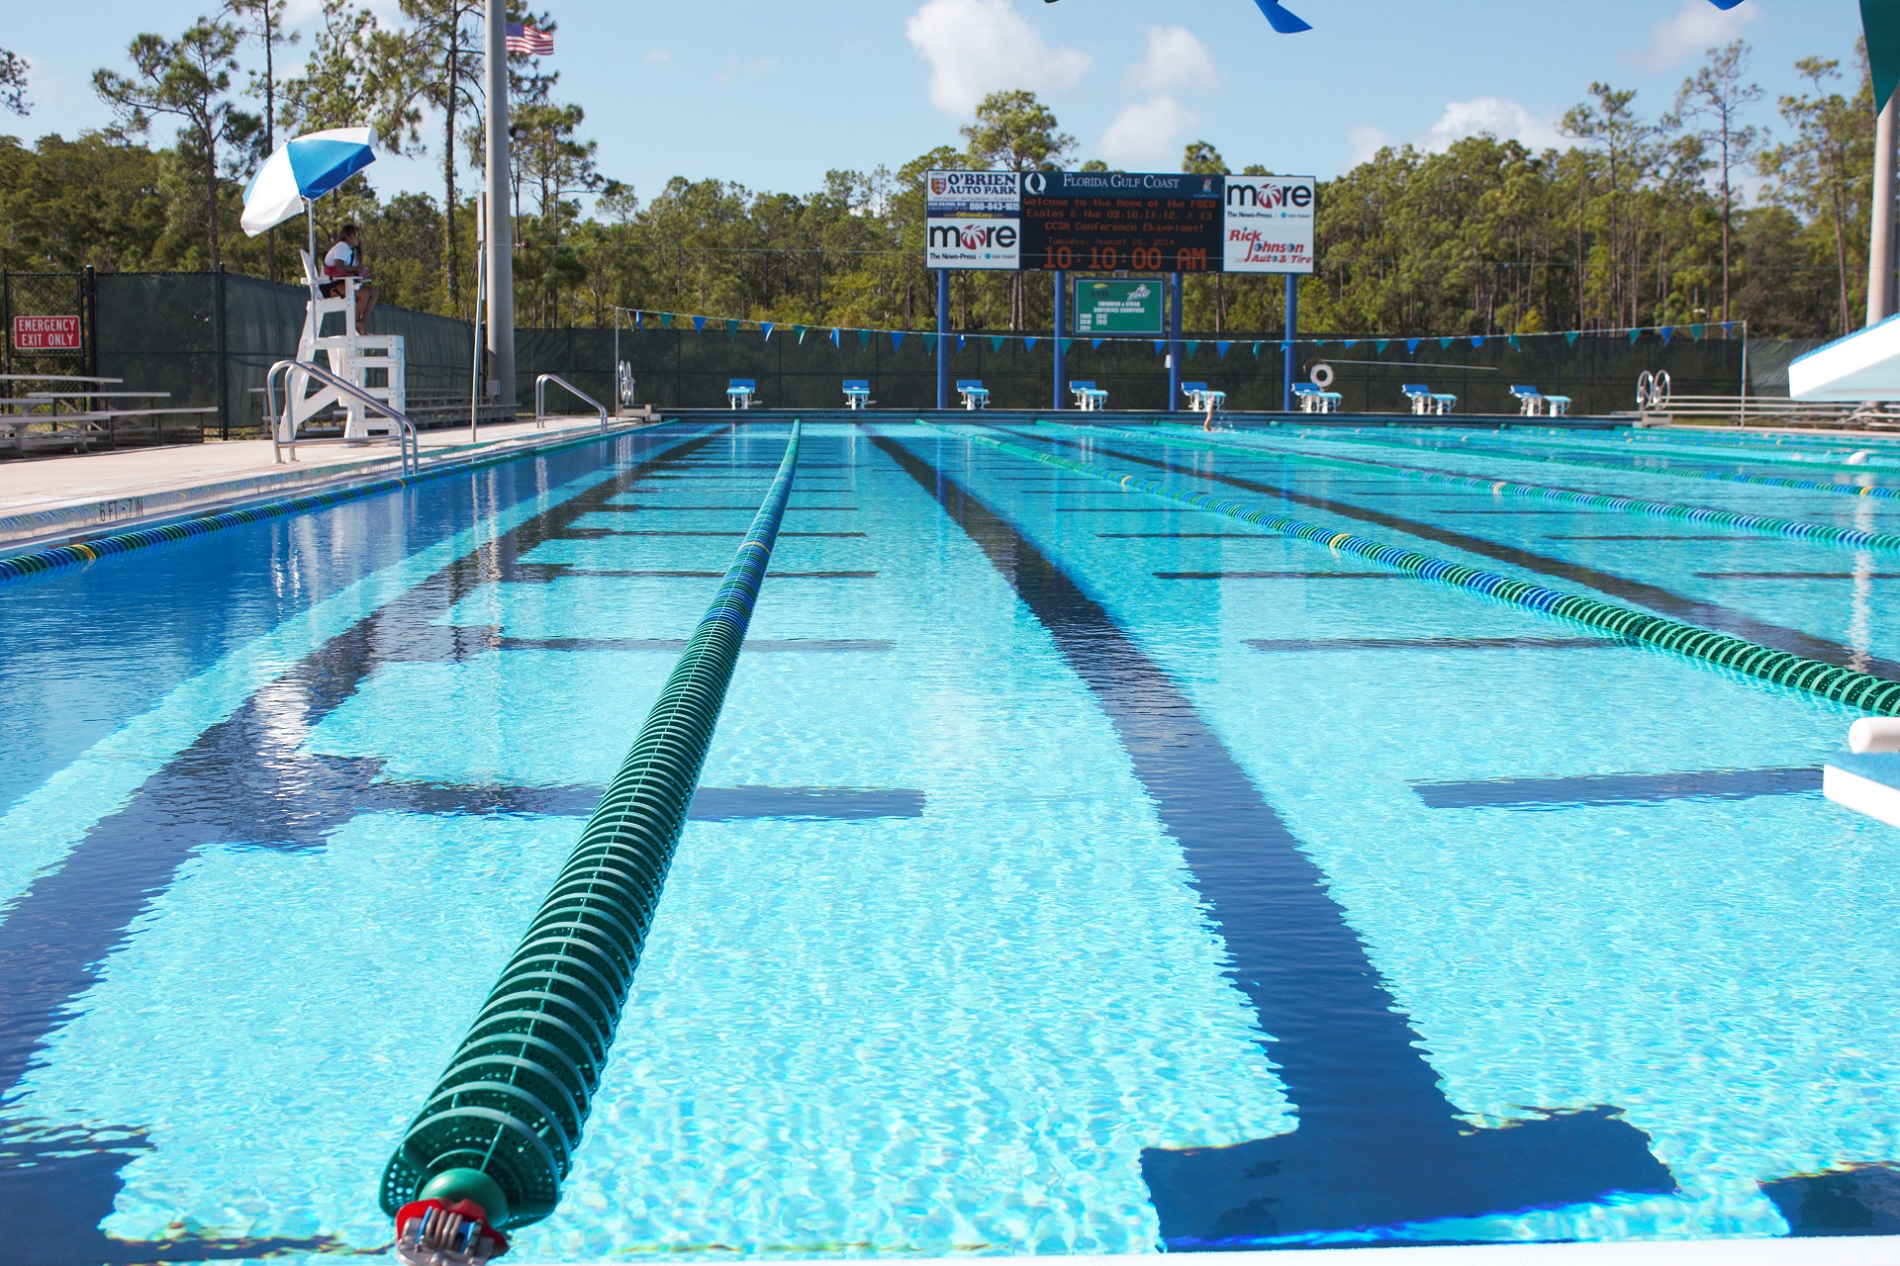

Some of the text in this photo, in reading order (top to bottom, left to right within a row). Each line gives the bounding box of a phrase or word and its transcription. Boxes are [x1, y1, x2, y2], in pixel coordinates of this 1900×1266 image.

[948, 174, 1017, 186] O'BRIEN
[1063, 174, 1180, 189] FLORIDA GULF COAST
[948, 186, 1017, 194] AUTO PARK
[1024, 198, 1068, 206] Welcome
[1075, 198, 1086, 206] to
[1093, 198, 1111, 206] the
[1117, 199, 1142, 207] Home
[1148, 199, 1159, 208] of
[1167, 200, 1185, 208] the
[1026, 209, 1064, 218] Eagles
[1084, 210, 1101, 218] the
[1200, 212, 1212, 220] 13
[1075, 222, 1137, 231] Conference
[1143, 223, 1204, 232] Champions!
[1229, 226, 1262, 242] Rick
[1153, 238, 1175, 246] 2014
[1244, 236, 1304, 262] Johnson
[1043, 246, 1206, 271] 10:10:00 AM
[1251, 254, 1311, 263] Auto & Tire
[19, 319, 75, 332] EMERGENCY
[22, 334, 73, 346] EXIT ONLY
